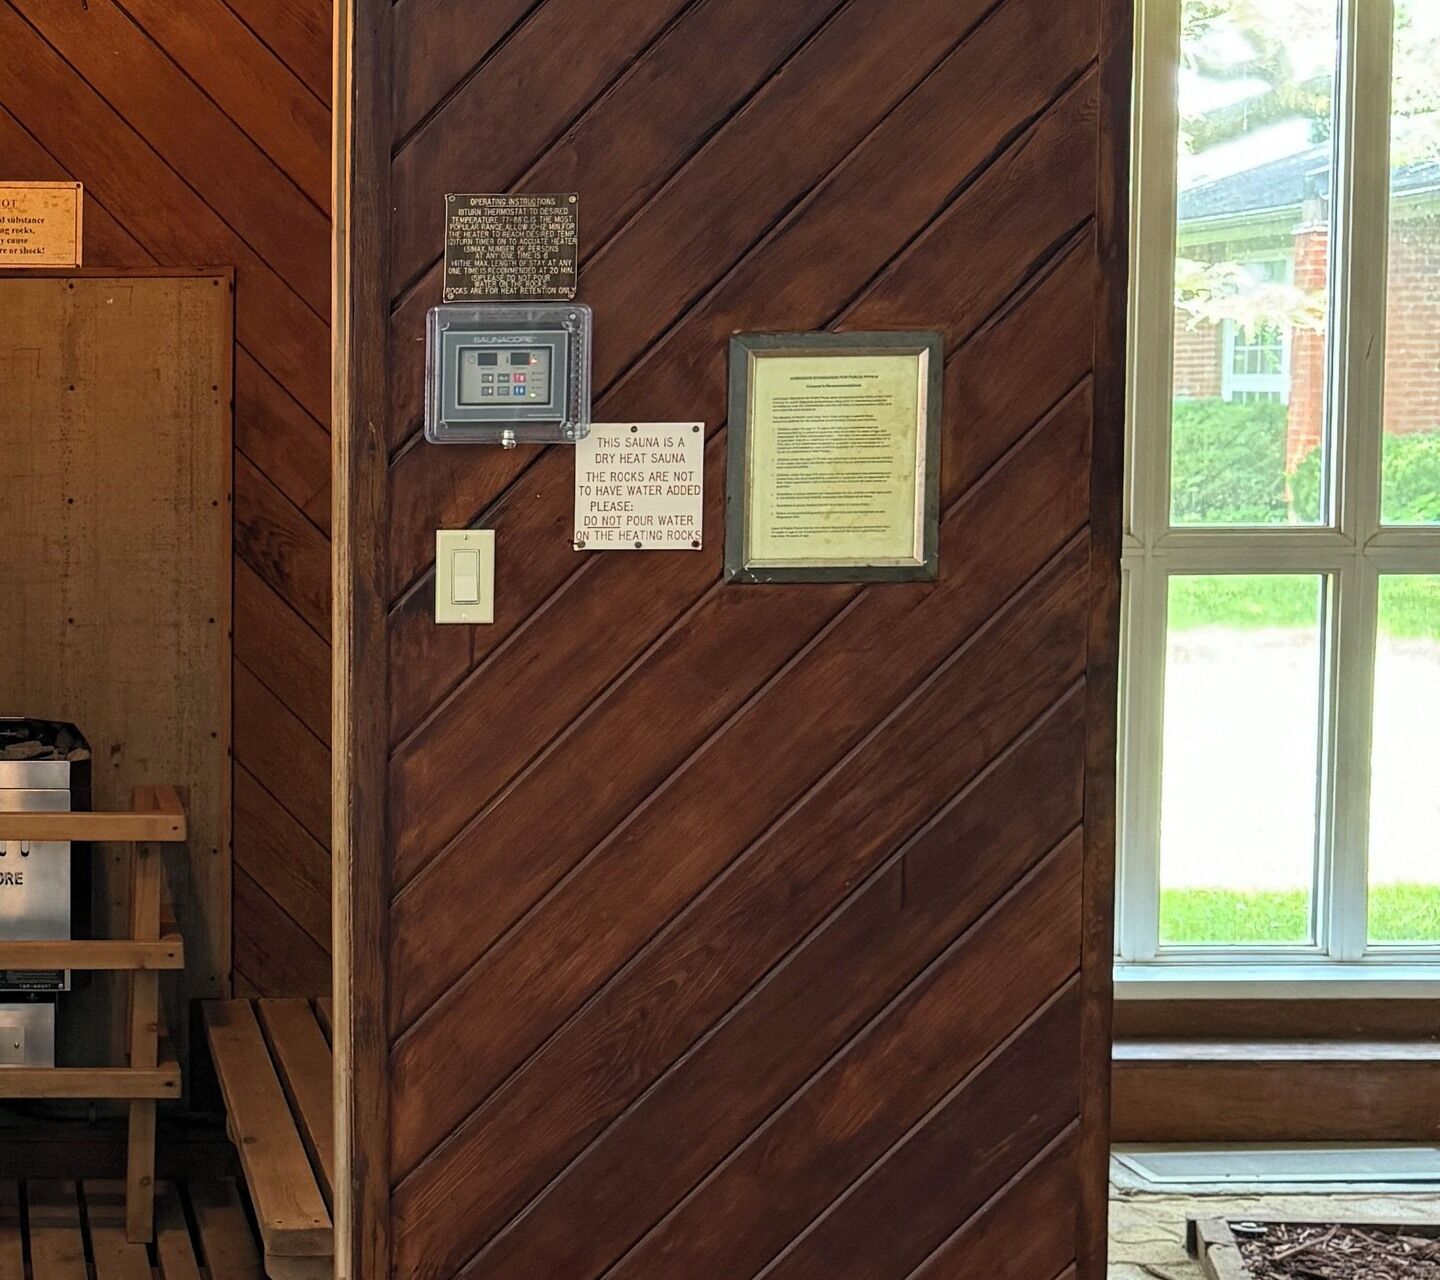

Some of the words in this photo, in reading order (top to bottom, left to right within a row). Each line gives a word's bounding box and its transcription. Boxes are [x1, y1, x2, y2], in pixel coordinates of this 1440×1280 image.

[470, 198, 506, 206] OPERATING
[508, 198, 556, 206] INSTRUCTIONS
[7, 216, 45, 224] substance
[20, 246, 45, 254] shock!
[597, 437, 621, 448] THIS
[625, 437, 659, 448] SAUNA
[663, 437, 674, 448] IS
[678, 437, 685, 448] A
[595, 453, 616, 464] DRY
[620, 453, 647, 464] HEAT
[651, 453, 686, 464] SAUNA
[586, 471, 606, 482] THE
[610, 471, 645, 482] ROCKS
[649, 471, 669, 482] ARE
[673, 471, 694, 482] NOT
[579, 485, 591, 496] TO
[596, 485, 623, 496] HAVE
[627, 485, 662, 496] WATER
[666, 485, 701, 496] ADDED
[590, 501, 634, 512] PLEASE:
[584, 515, 598, 526] DO
[602, 515, 622, 526] NOT
[627, 515, 654, 526] POUR
[658, 515, 694, 526] WATER
[576, 531, 590, 541] ON
[595, 531, 614, 541] THE
[619, 531, 663, 541] HEATING
[667, 531, 702, 541] ROCKS
